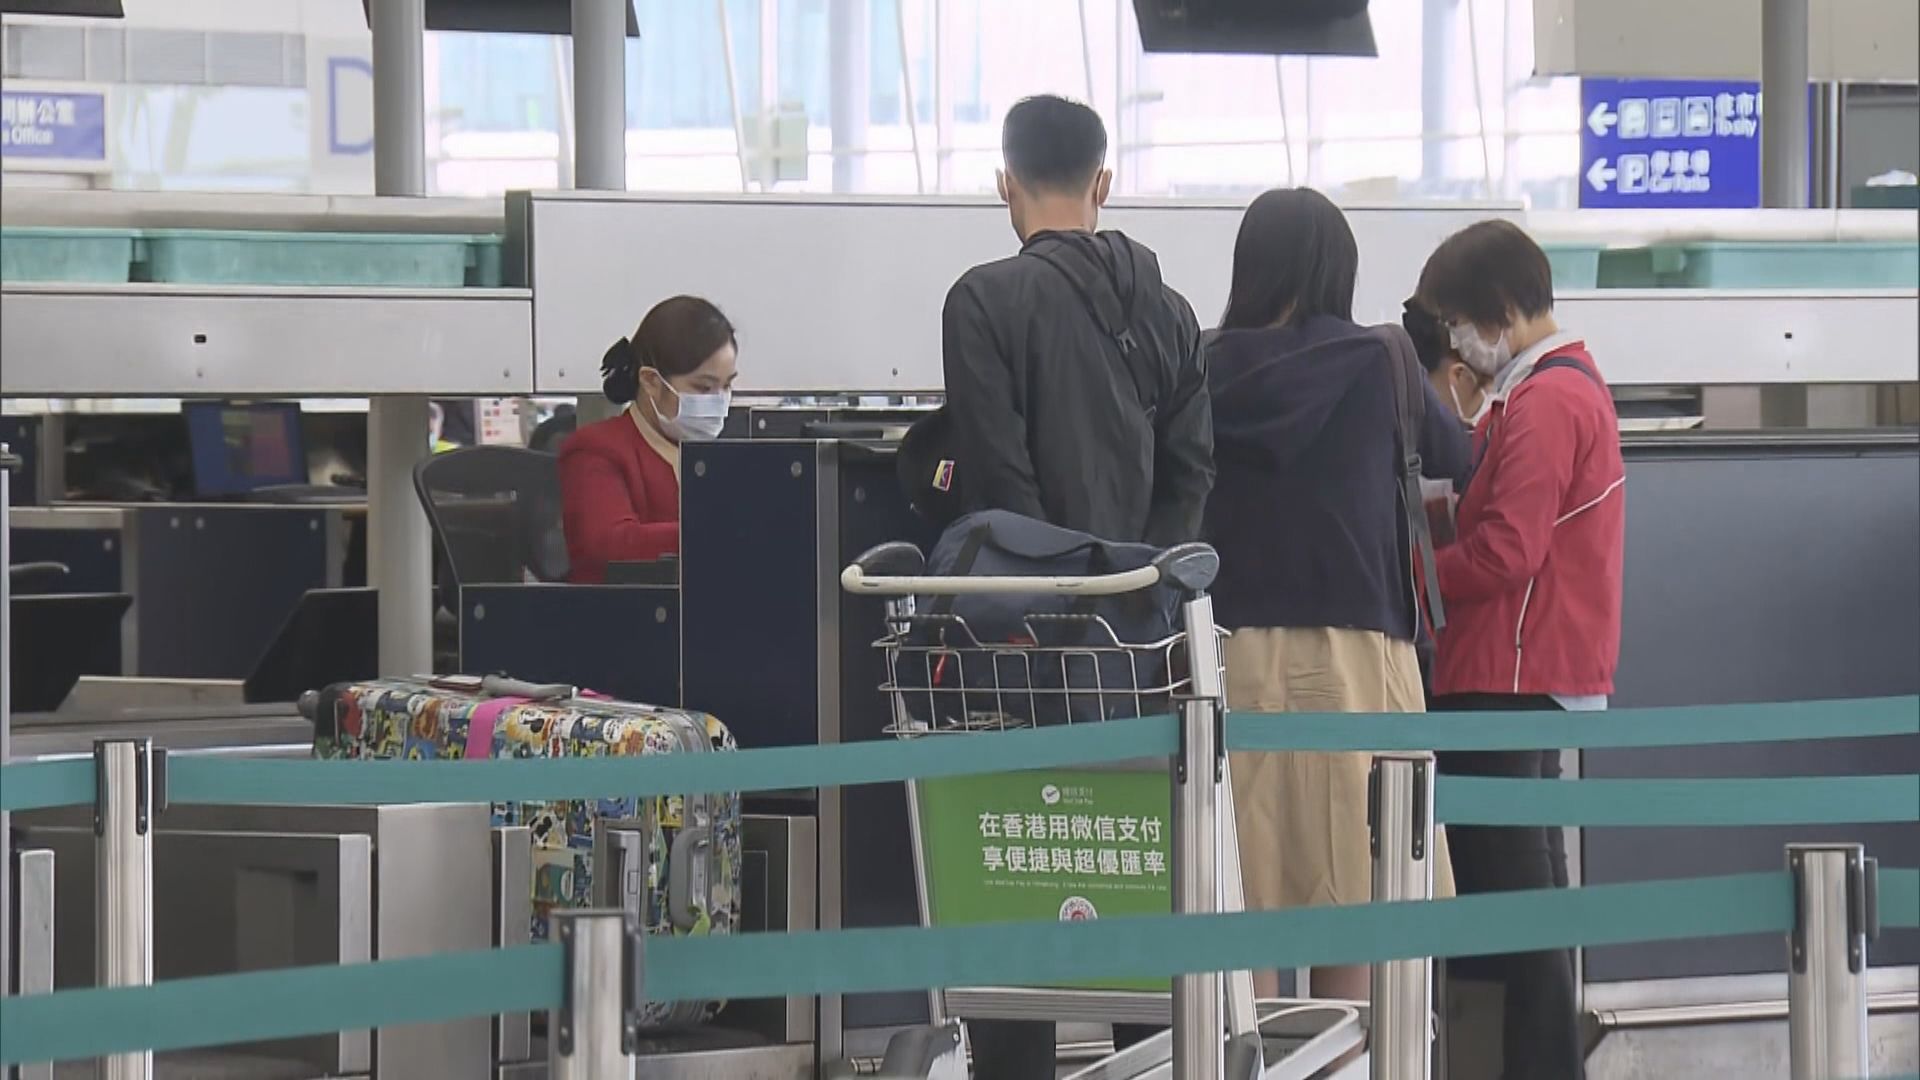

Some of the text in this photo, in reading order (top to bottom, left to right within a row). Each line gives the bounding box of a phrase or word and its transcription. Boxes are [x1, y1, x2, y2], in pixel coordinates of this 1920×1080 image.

[327, 57, 374, 155] D
[12, 126, 54, 145] Office
[979, 811, 1162, 843] 在香港用微信支付
[982, 845, 1166, 877] 享便捷與超優匯率
